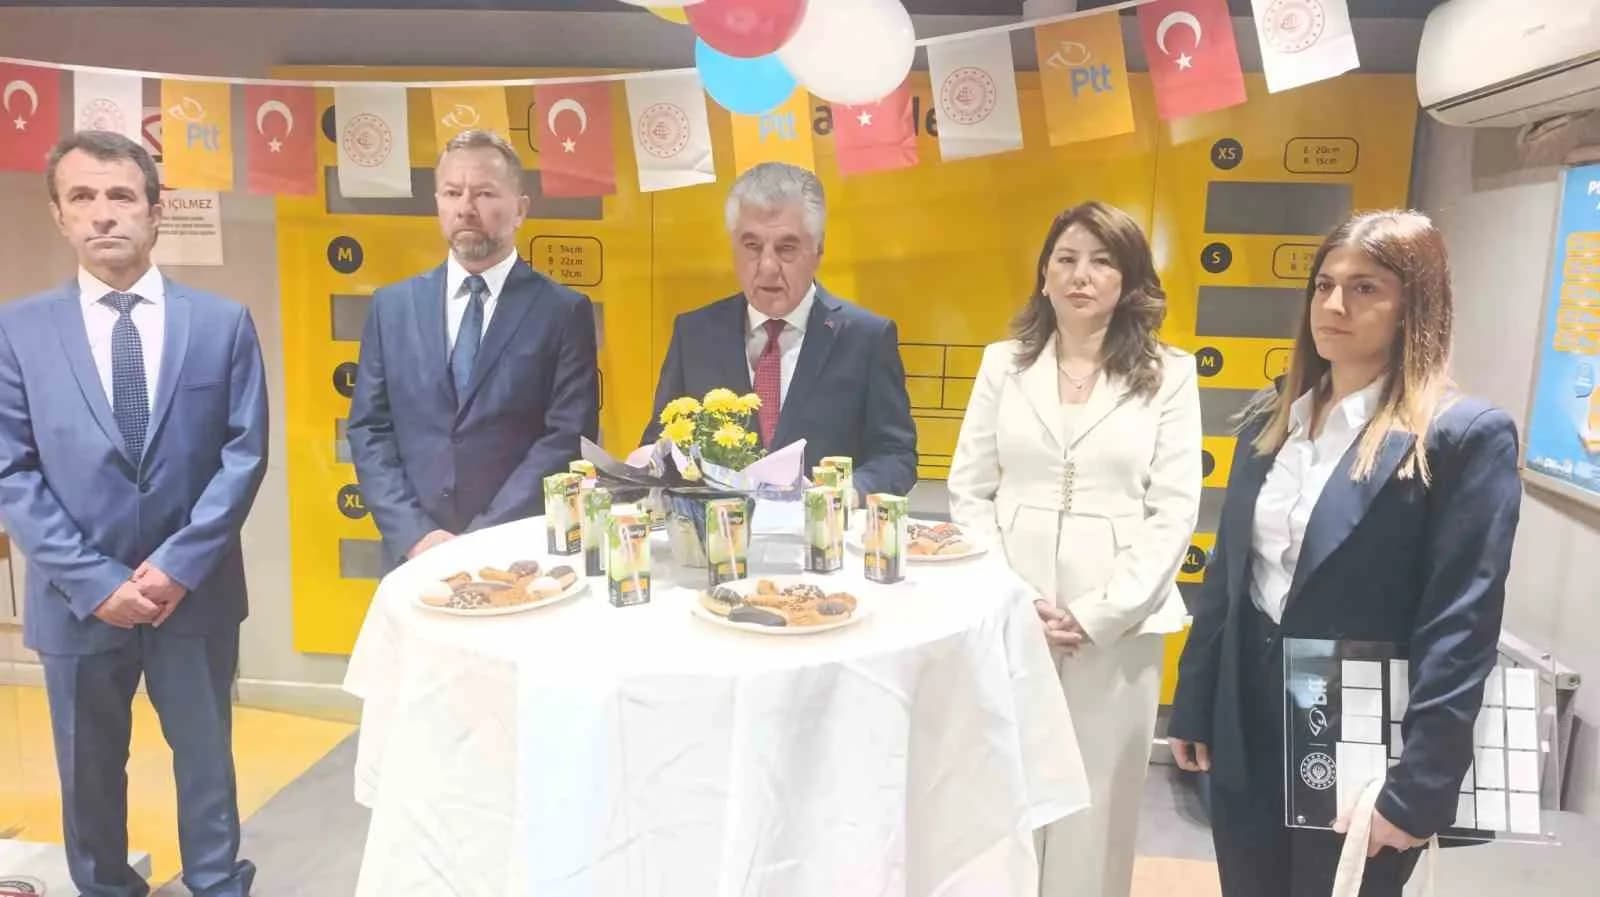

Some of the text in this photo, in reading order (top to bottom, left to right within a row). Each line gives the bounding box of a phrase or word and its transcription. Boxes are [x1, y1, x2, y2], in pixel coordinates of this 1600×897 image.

[1071, 66, 1112, 97] Ptt
[759, 111, 798, 143] Ptt
[187, 123, 221, 149] Ptt
[1218, 148, 1236, 160] XS
[338, 247, 353, 262] M
[1212, 251, 1221, 264] S
[1200, 355, 1215, 368] M
[346, 373, 355, 386] L
[344, 494, 364, 508] XL
